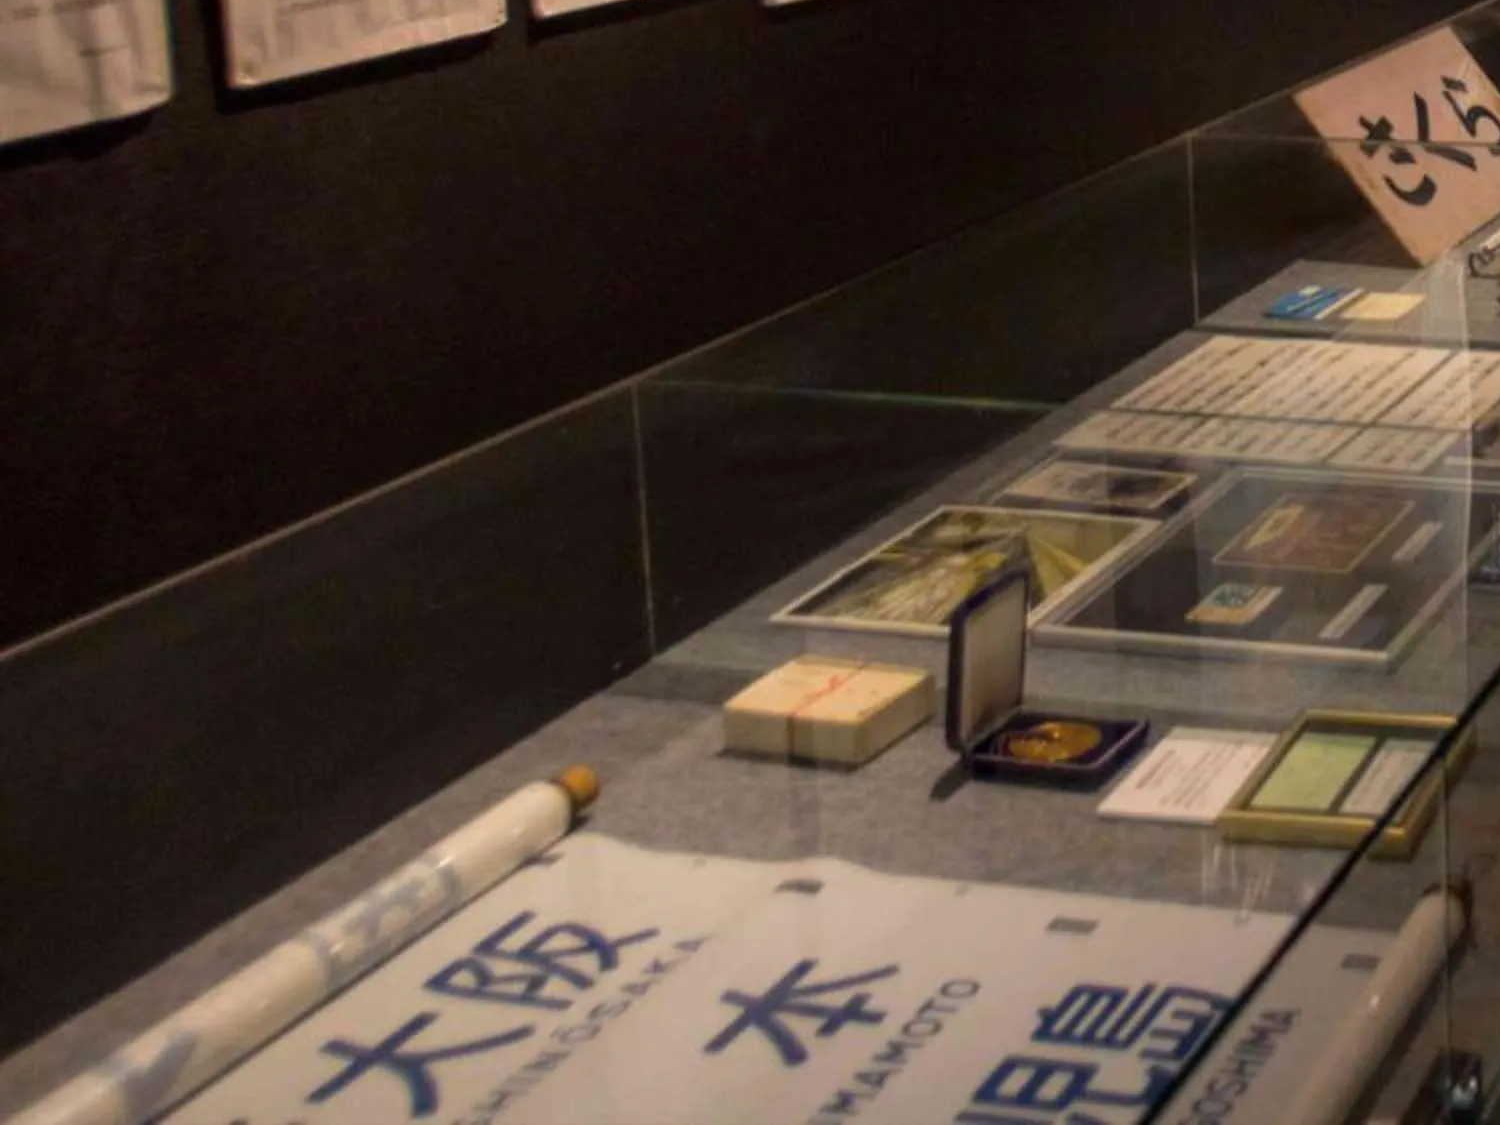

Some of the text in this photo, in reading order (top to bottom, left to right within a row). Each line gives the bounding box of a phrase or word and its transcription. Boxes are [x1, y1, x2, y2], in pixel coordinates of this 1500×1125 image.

[228, 909, 662, 1125] 大阪
[704, 958, 900, 1067] 本
[805, 978, 981, 1125] MAMOTO
